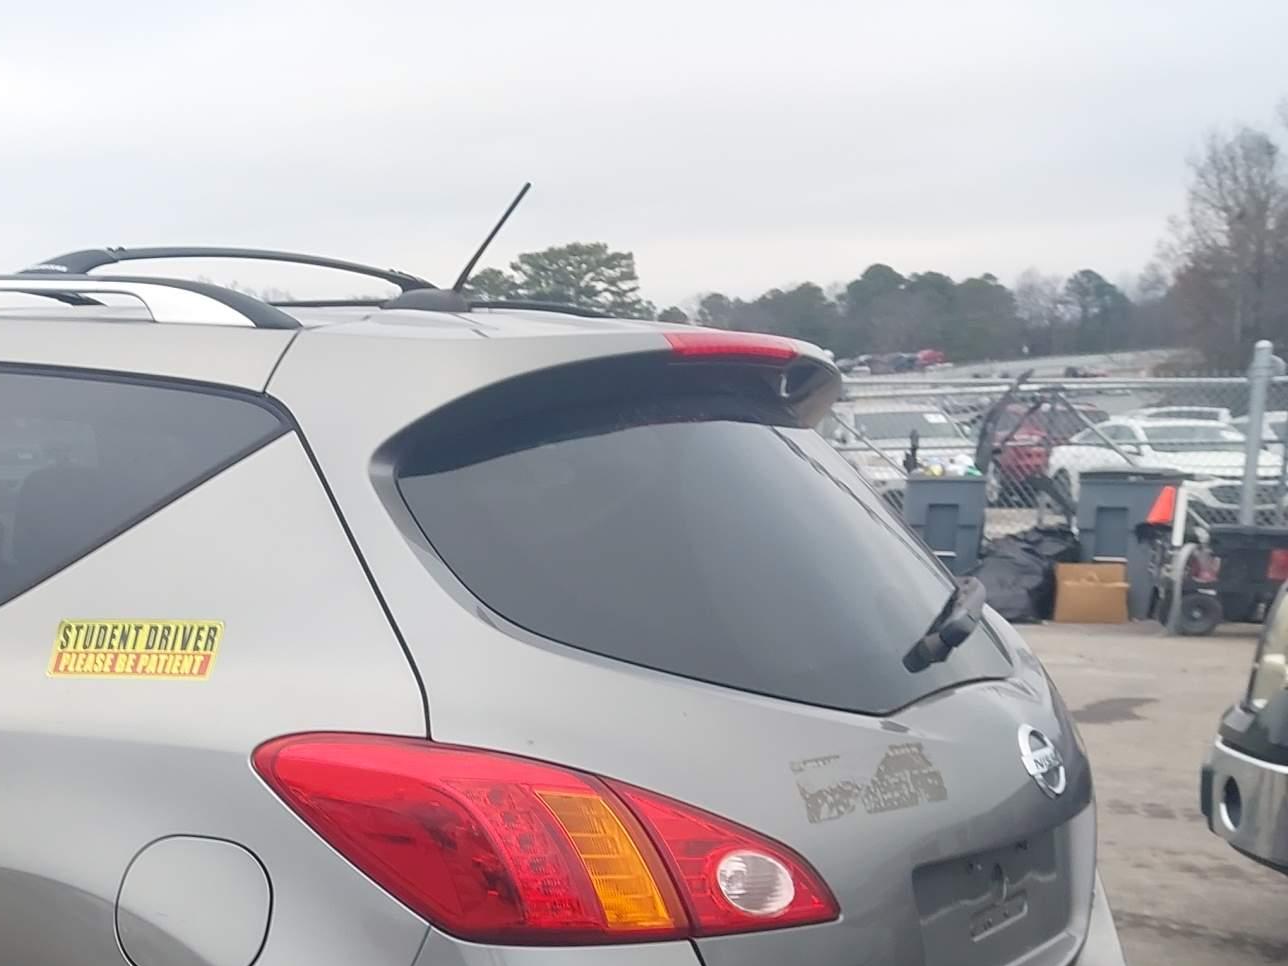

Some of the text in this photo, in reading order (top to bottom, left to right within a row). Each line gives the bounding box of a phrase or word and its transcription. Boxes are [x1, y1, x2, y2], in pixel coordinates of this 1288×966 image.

[60, 624, 217, 651] STUDENT DRIVER
[59, 653, 204, 675] PLEASE BE PATIENT
